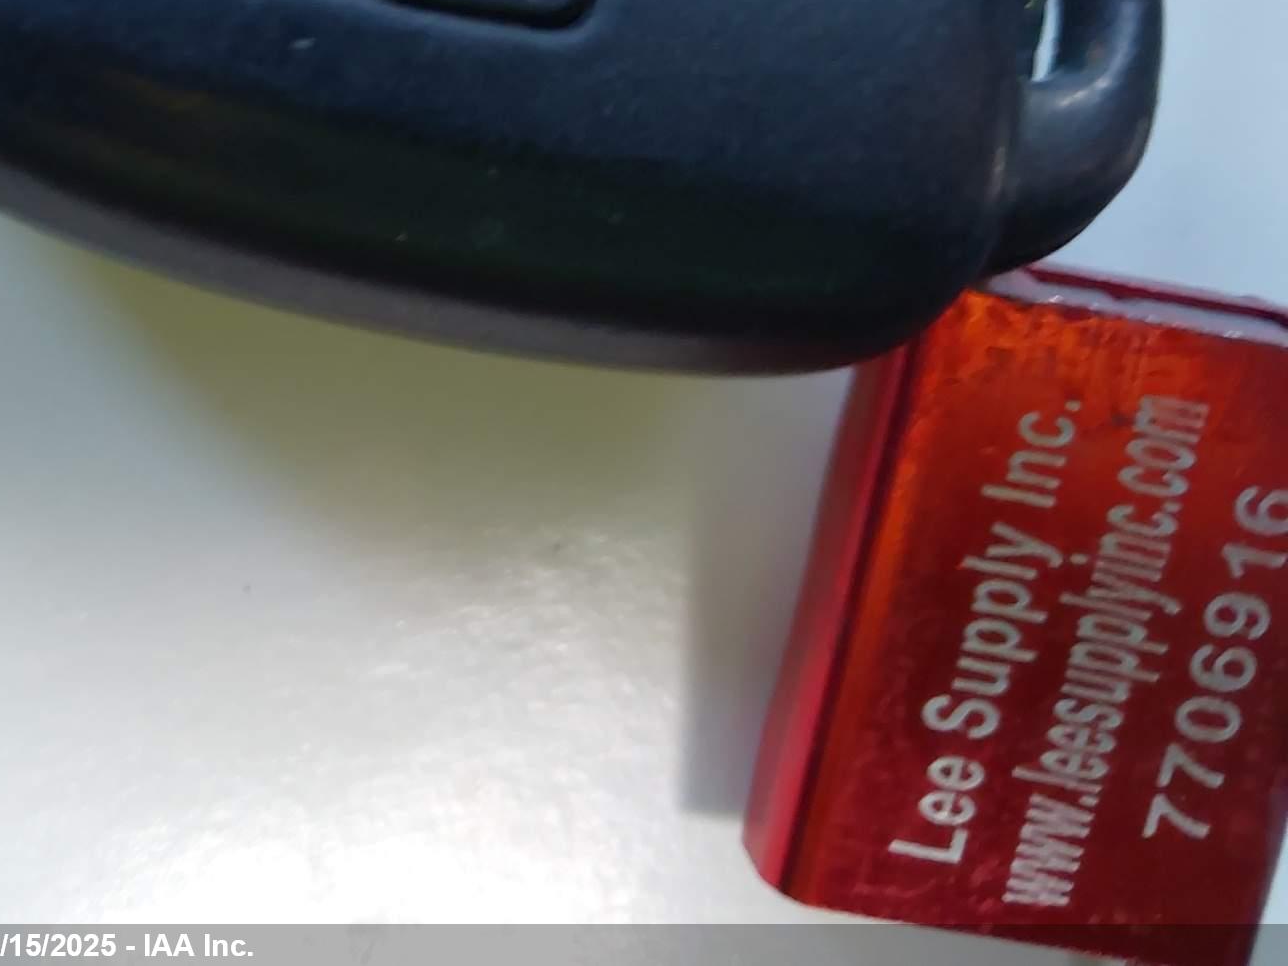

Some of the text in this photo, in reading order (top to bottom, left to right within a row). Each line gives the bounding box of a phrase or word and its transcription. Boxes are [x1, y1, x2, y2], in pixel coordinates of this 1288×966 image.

[888, 398, 1082, 864] Lee Supply Inc.
[1002, 395, 1210, 907] www.leesupplyinc.com
[1142, 485, 1288, 839] 7706916
